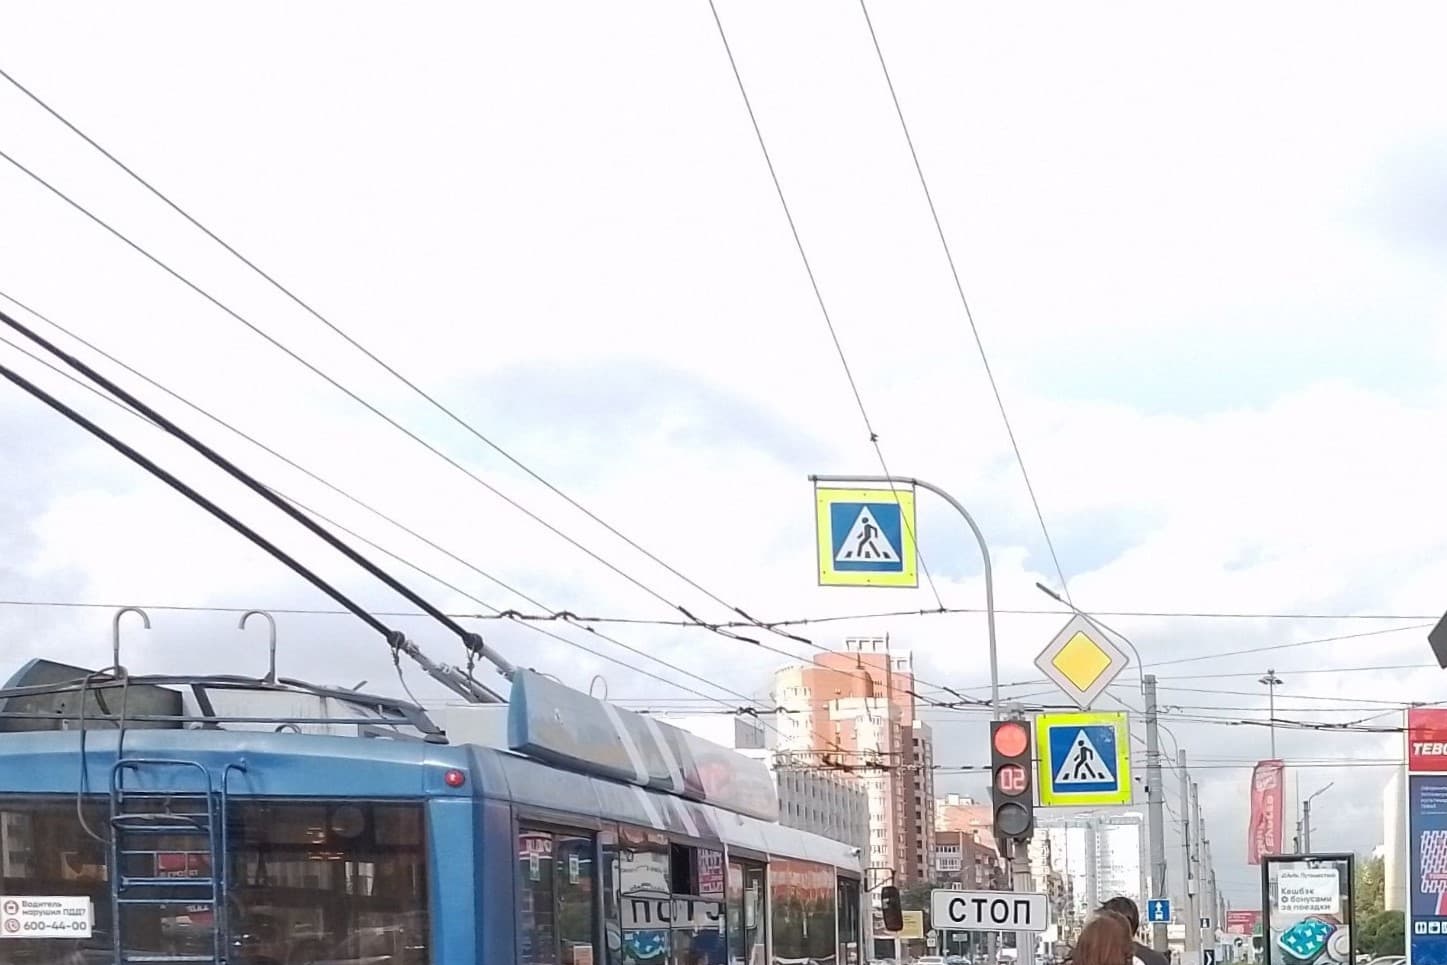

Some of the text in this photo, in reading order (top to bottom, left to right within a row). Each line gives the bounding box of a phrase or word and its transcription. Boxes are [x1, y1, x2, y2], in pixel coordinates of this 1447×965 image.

[1001, 767, 1025, 791] 02
[22, 900, 62, 909] Водитель
[948, 897, 1032, 926] СТОП
[24, 921, 87, 931] 600-44-00
